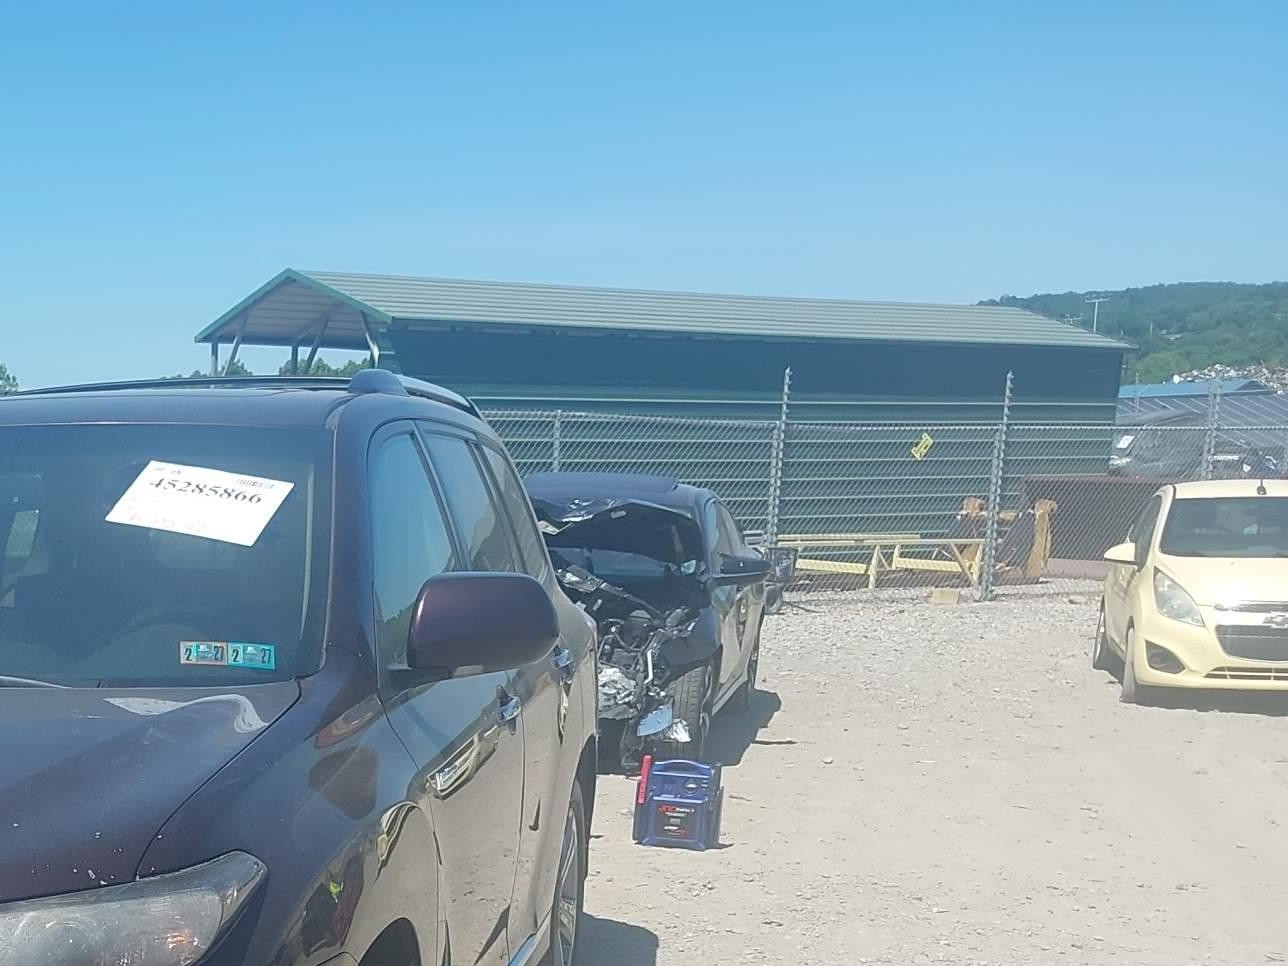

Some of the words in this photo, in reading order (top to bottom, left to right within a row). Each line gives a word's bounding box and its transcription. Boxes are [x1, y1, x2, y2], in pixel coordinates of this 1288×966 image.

[149, 477, 263, 504] 45285866
[184, 647, 193, 662] 2
[213, 645, 225, 662] 27
[231, 648, 240, 663] 2
[260, 647, 272, 665] 27
